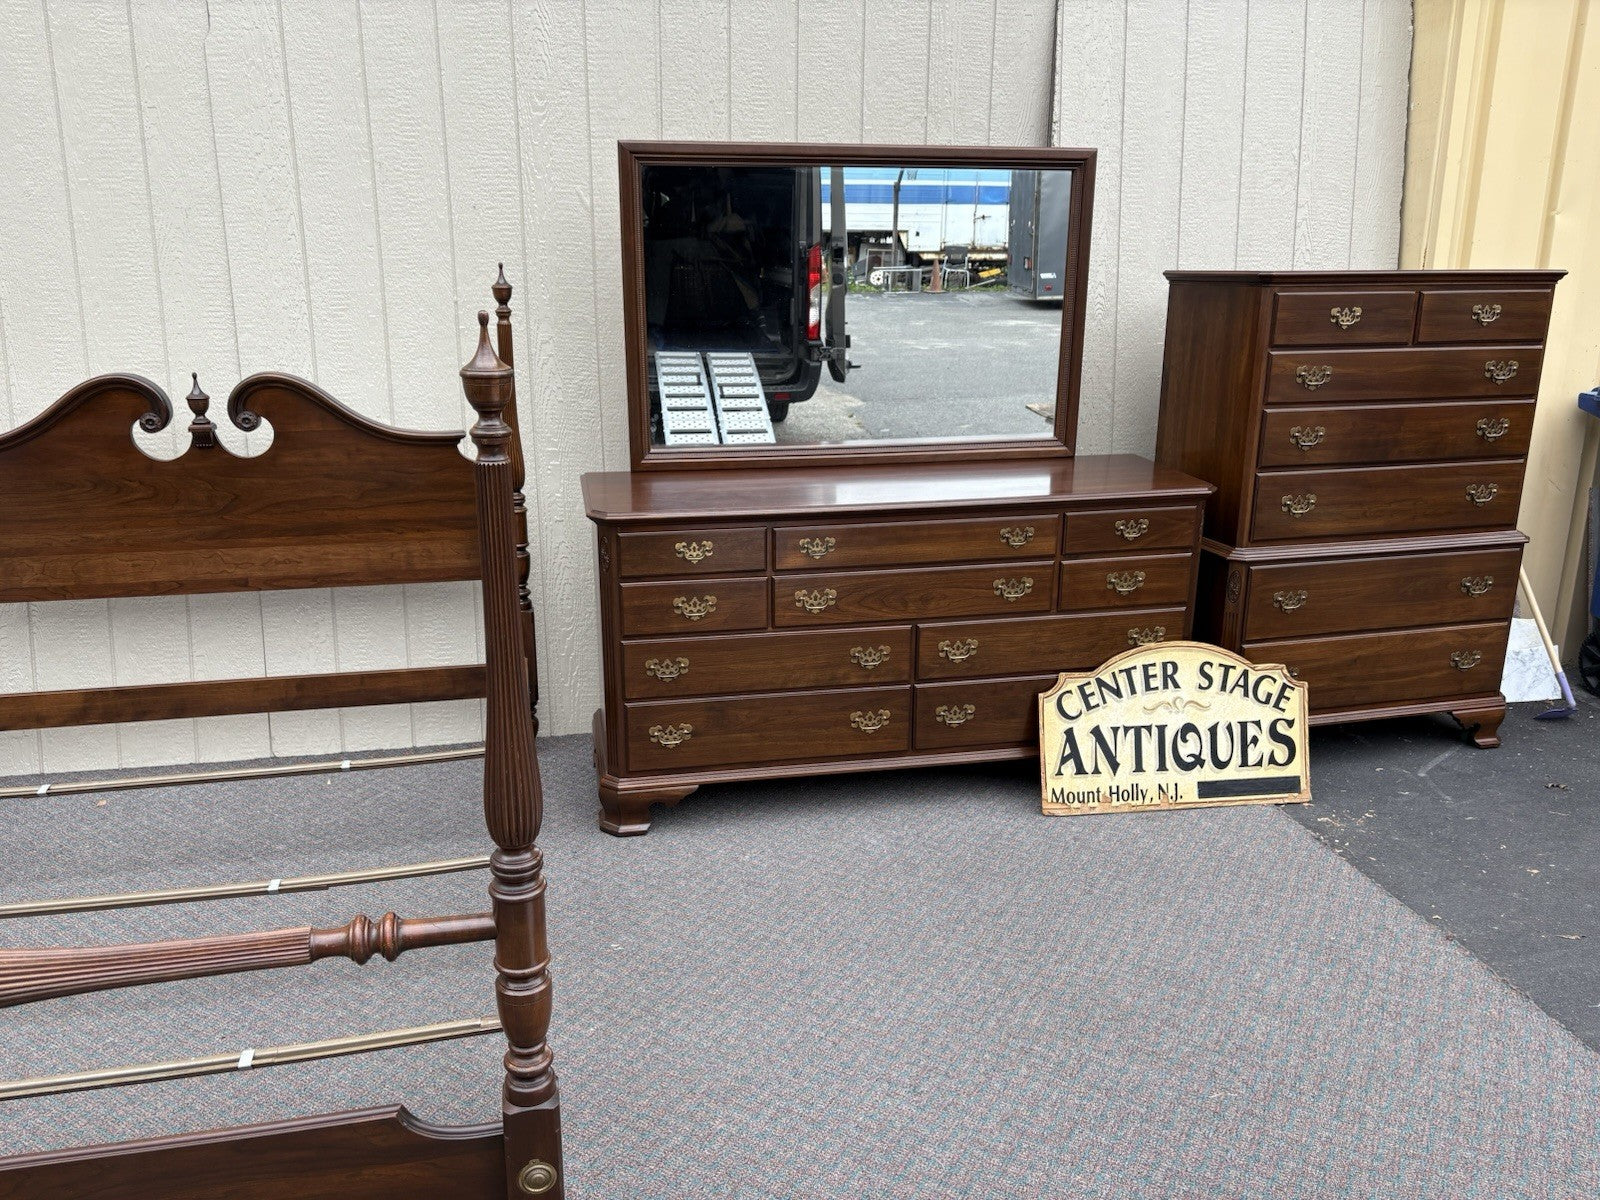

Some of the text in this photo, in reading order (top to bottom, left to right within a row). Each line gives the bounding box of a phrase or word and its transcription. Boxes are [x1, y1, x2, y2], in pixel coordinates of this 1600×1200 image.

[1056, 660, 1296, 721] CENTER STAGE
[1054, 717, 1297, 777] ANTIQUES
[1051, 782, 1183, 804] Mount Holly, N.J.
